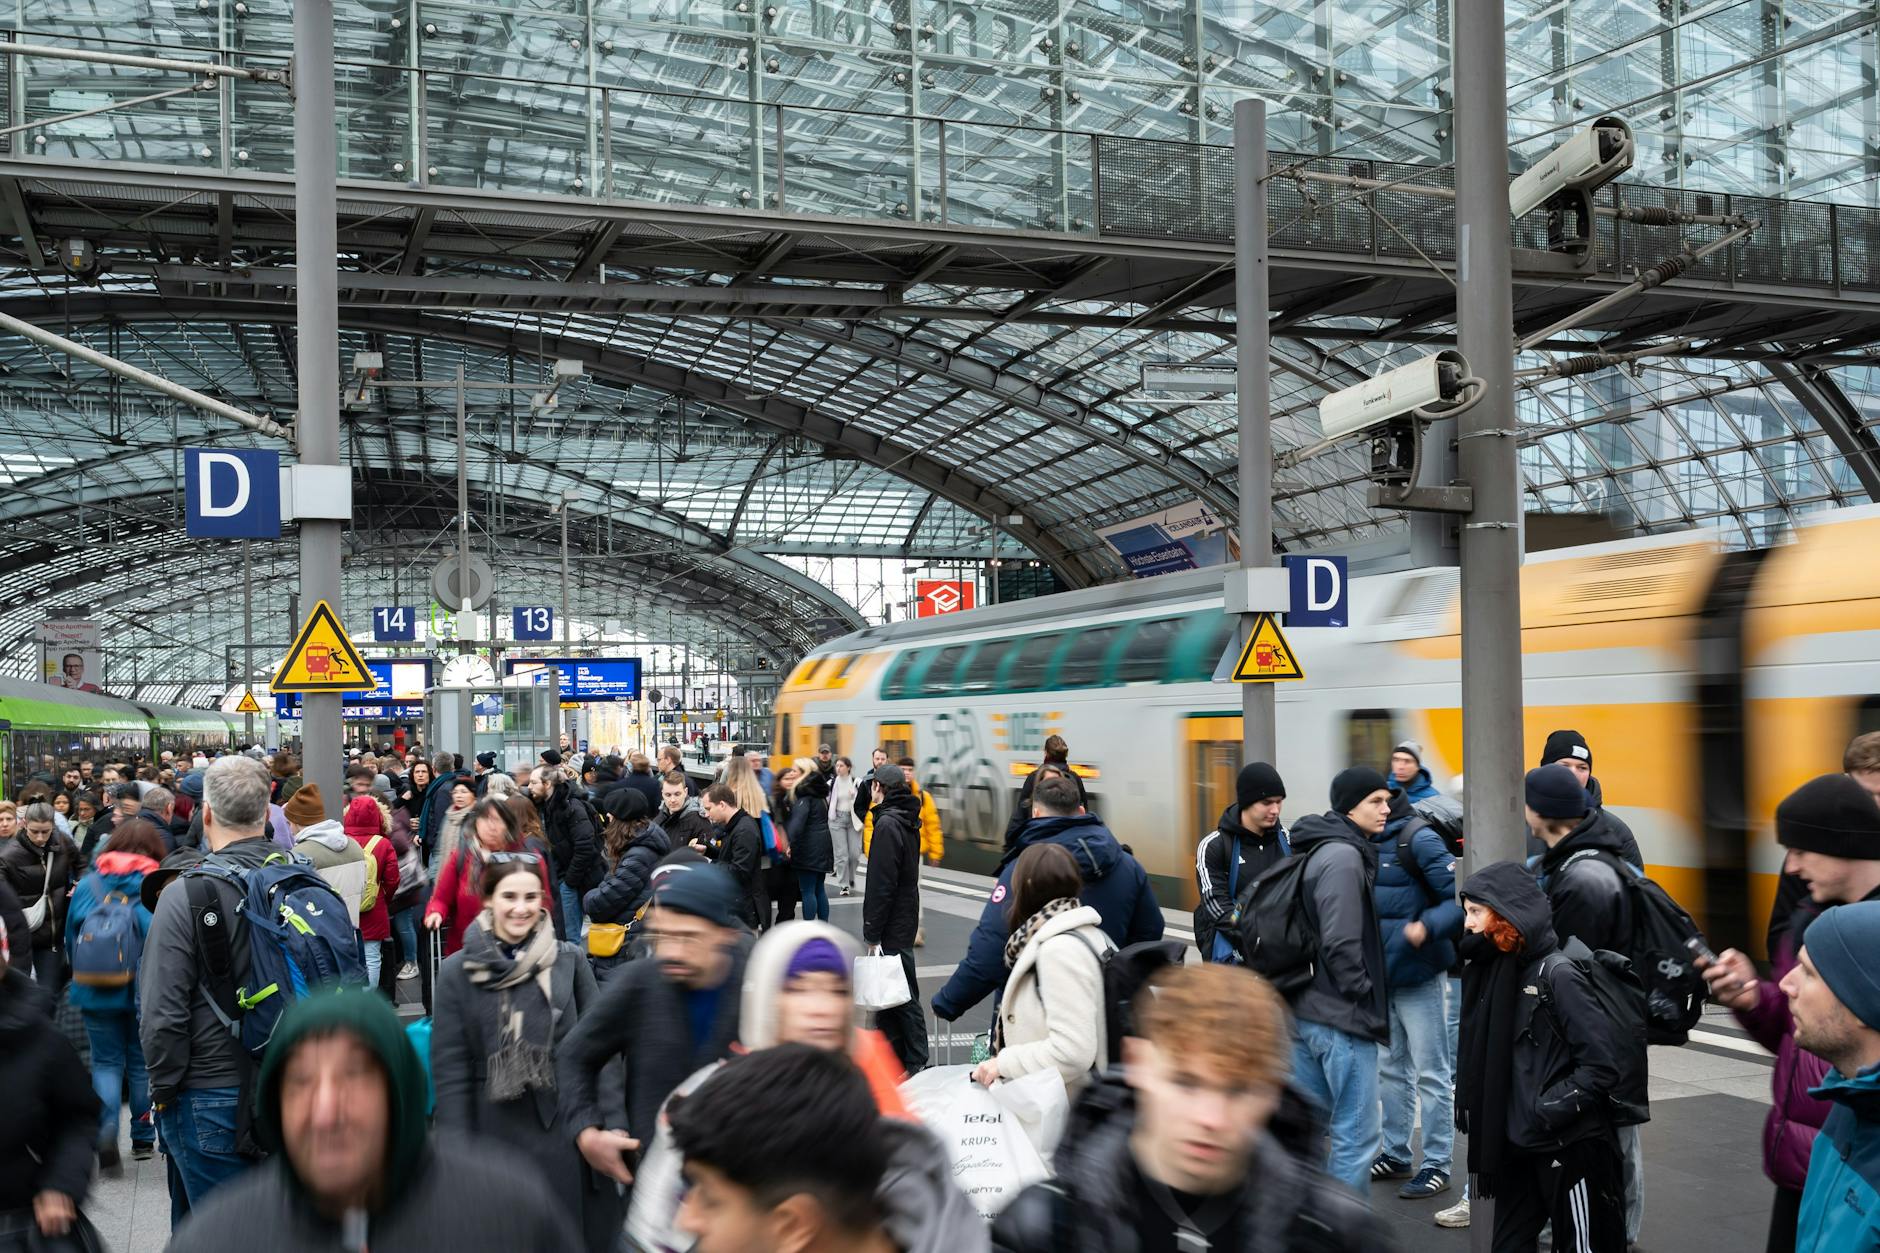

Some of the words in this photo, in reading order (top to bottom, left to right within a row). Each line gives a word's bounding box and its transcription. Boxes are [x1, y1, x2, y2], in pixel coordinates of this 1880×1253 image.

[199, 452, 251, 517] D
[1307, 558, 1341, 611] D
[377, 607, 407, 633] 14
[521, 607, 550, 632] 13
[964, 1113, 1003, 1124] Tefal
[961, 1136, 998, 1146] KRUPS
